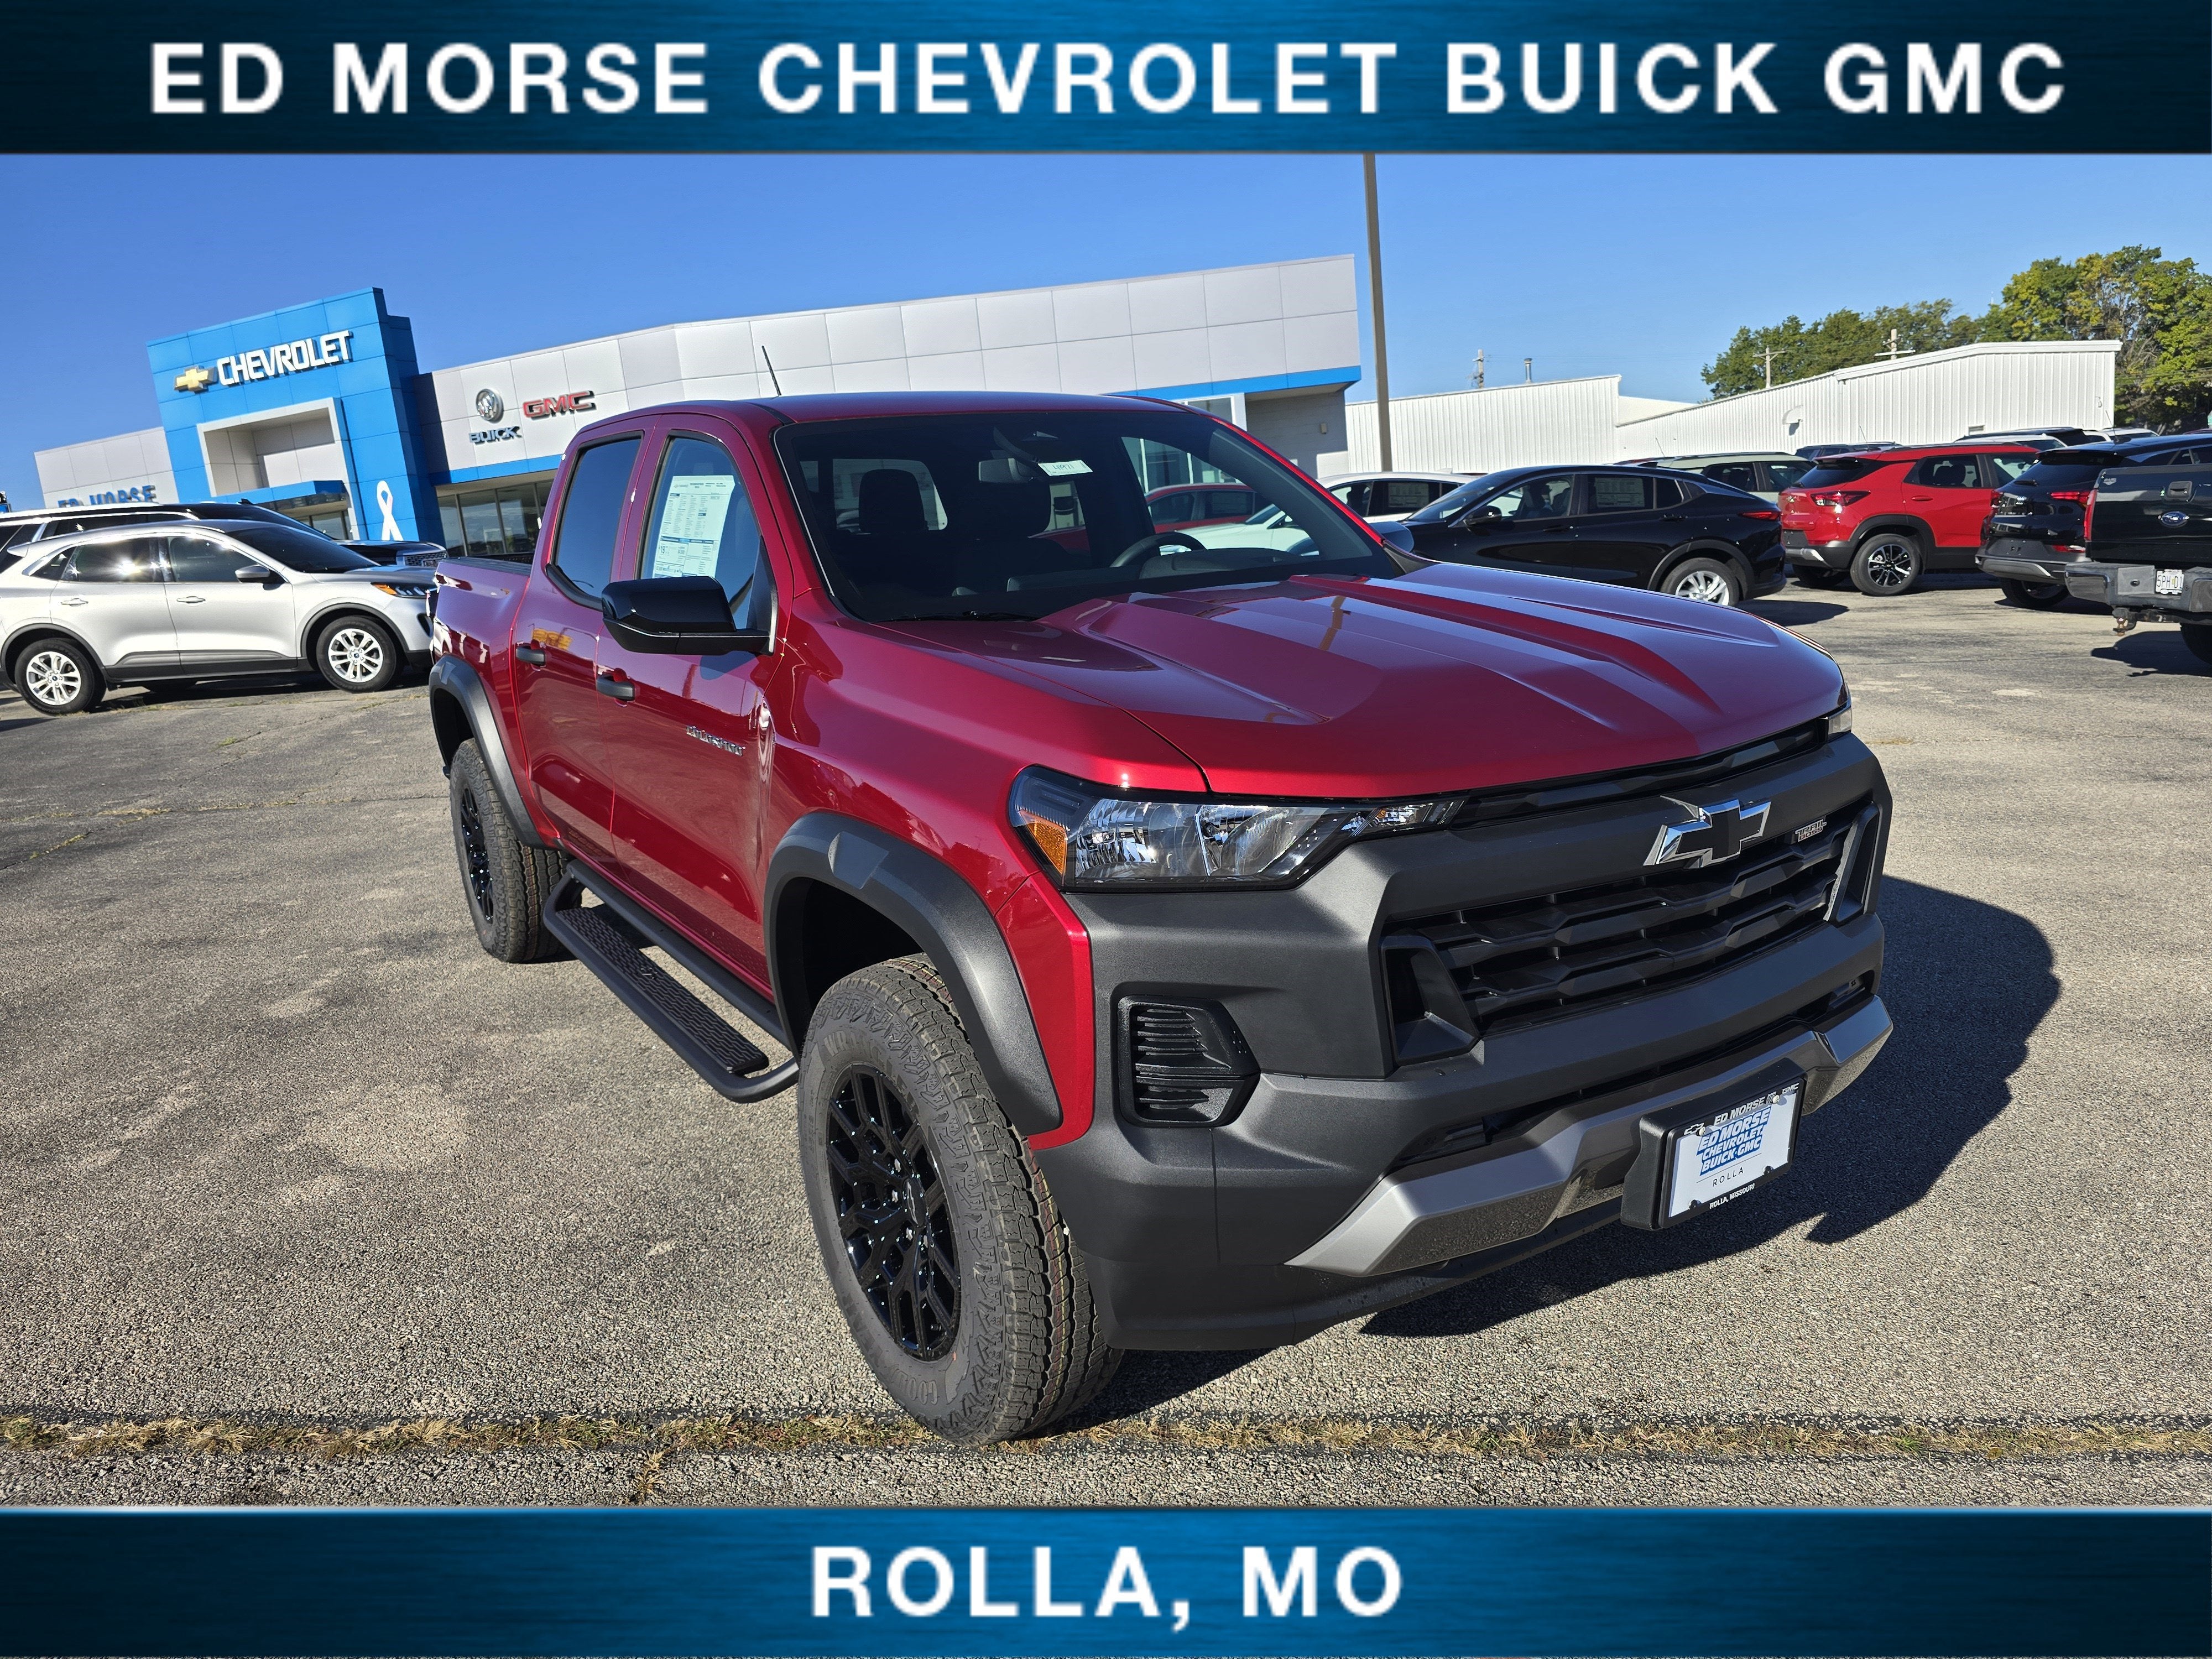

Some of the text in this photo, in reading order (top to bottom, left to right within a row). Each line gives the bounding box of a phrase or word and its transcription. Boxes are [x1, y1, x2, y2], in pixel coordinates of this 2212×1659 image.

[216, 330, 352, 386] CHEVROLET
[523, 390, 595, 418] GMC
[468, 426, 521, 444] BUICK
[1795, 819, 1827, 837] TRAIL
[1799, 827, 1823, 841] BOSS
[1782, 1082, 1799, 1095] GMC
[1714, 1096, 1766, 1125] ED MORSE
[1697, 1107, 1771, 1152] ED MORSE
[1701, 1136, 1762, 1173] BUICK GMC
[1712, 1166, 1744, 1187] ROLLA
[1709, 1183, 1756, 1210] ROLLA, MISSOURI
